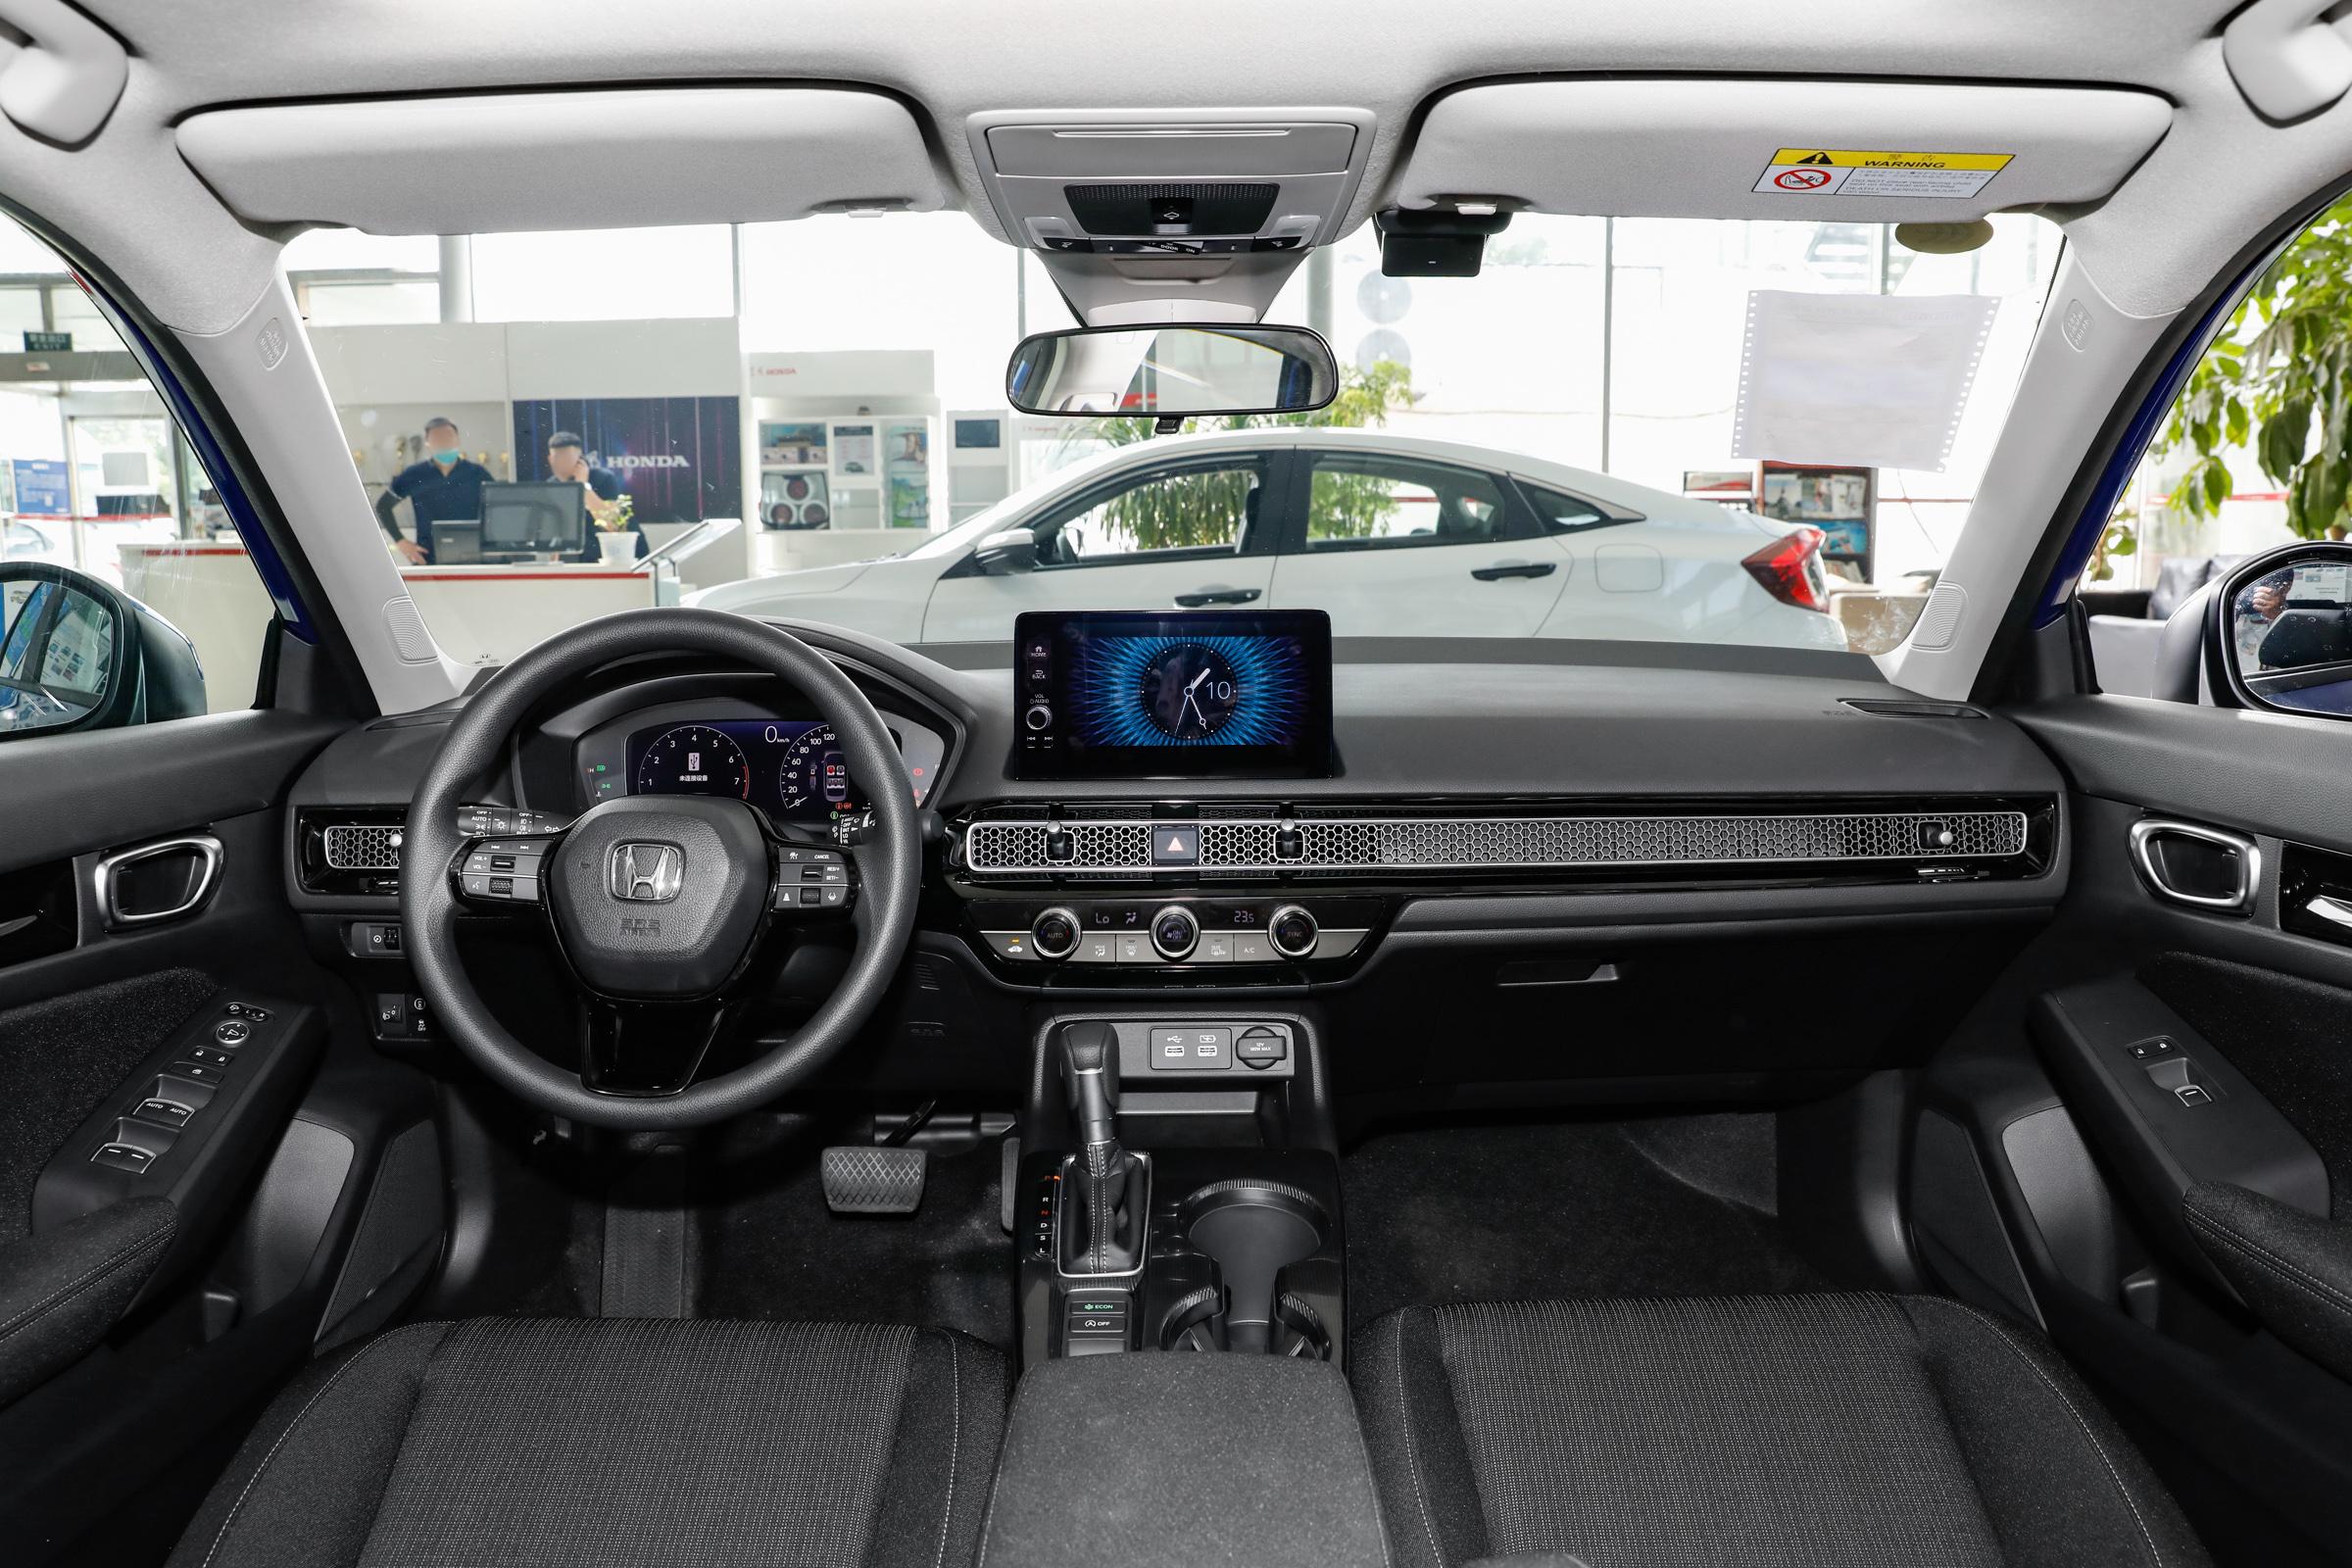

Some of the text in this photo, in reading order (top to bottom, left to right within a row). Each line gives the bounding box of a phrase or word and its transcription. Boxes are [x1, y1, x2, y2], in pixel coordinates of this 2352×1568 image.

[607, 455, 690, 467] HONDA
[1205, 681, 1231, 700] 10
[765, 725, 777, 743] 0
[788, 785, 798, 794] 20
